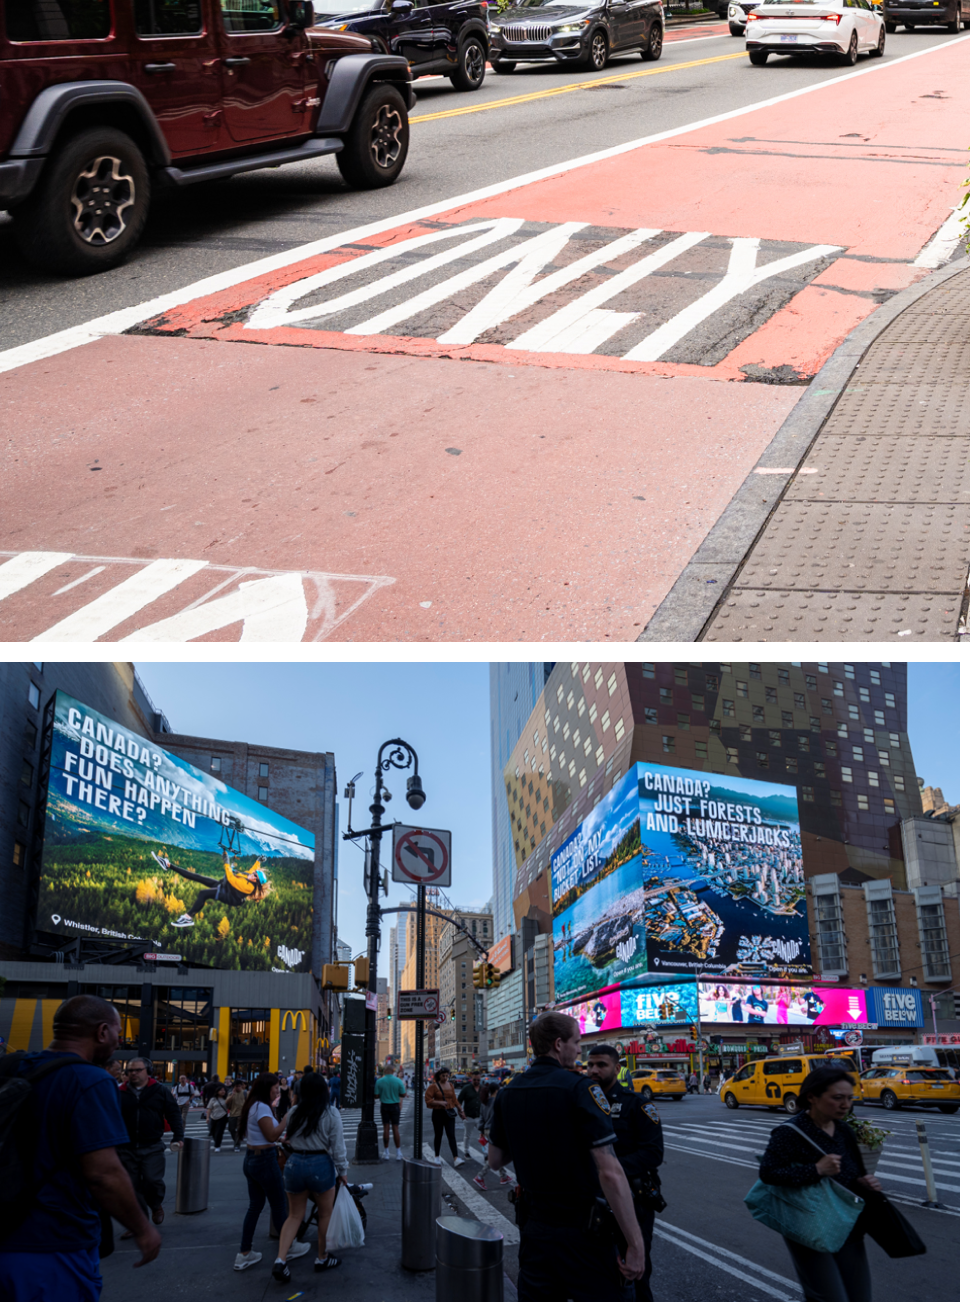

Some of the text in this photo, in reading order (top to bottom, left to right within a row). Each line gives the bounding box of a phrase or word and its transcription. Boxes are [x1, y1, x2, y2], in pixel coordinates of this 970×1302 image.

[243, 216, 848, 363] ONLY
[68, 707, 162, 771] CANADA?
[64, 750, 196, 830] FUN HAPPEN
[80, 735, 231, 827] DOES ANYTHING
[644, 771, 711, 799] CANADA?
[62, 772, 147, 826] THERE?
[654, 793, 762, 826] JUST FORESTS
[646, 812, 679, 834] AND
[552, 832, 582, 873] CANADA?
[588, 829, 603, 853] MY
[553, 849, 602, 903] BUCKET LIST.
[63, 918, 127, 940] Whistler, British
[661, 960, 689, 969] Vancouver,
[704, 962, 727, 971] Columbia
[883, 993, 916, 1010] five
[624, 1040, 646, 1055] villa
[665, 1039, 697, 1053] villa
